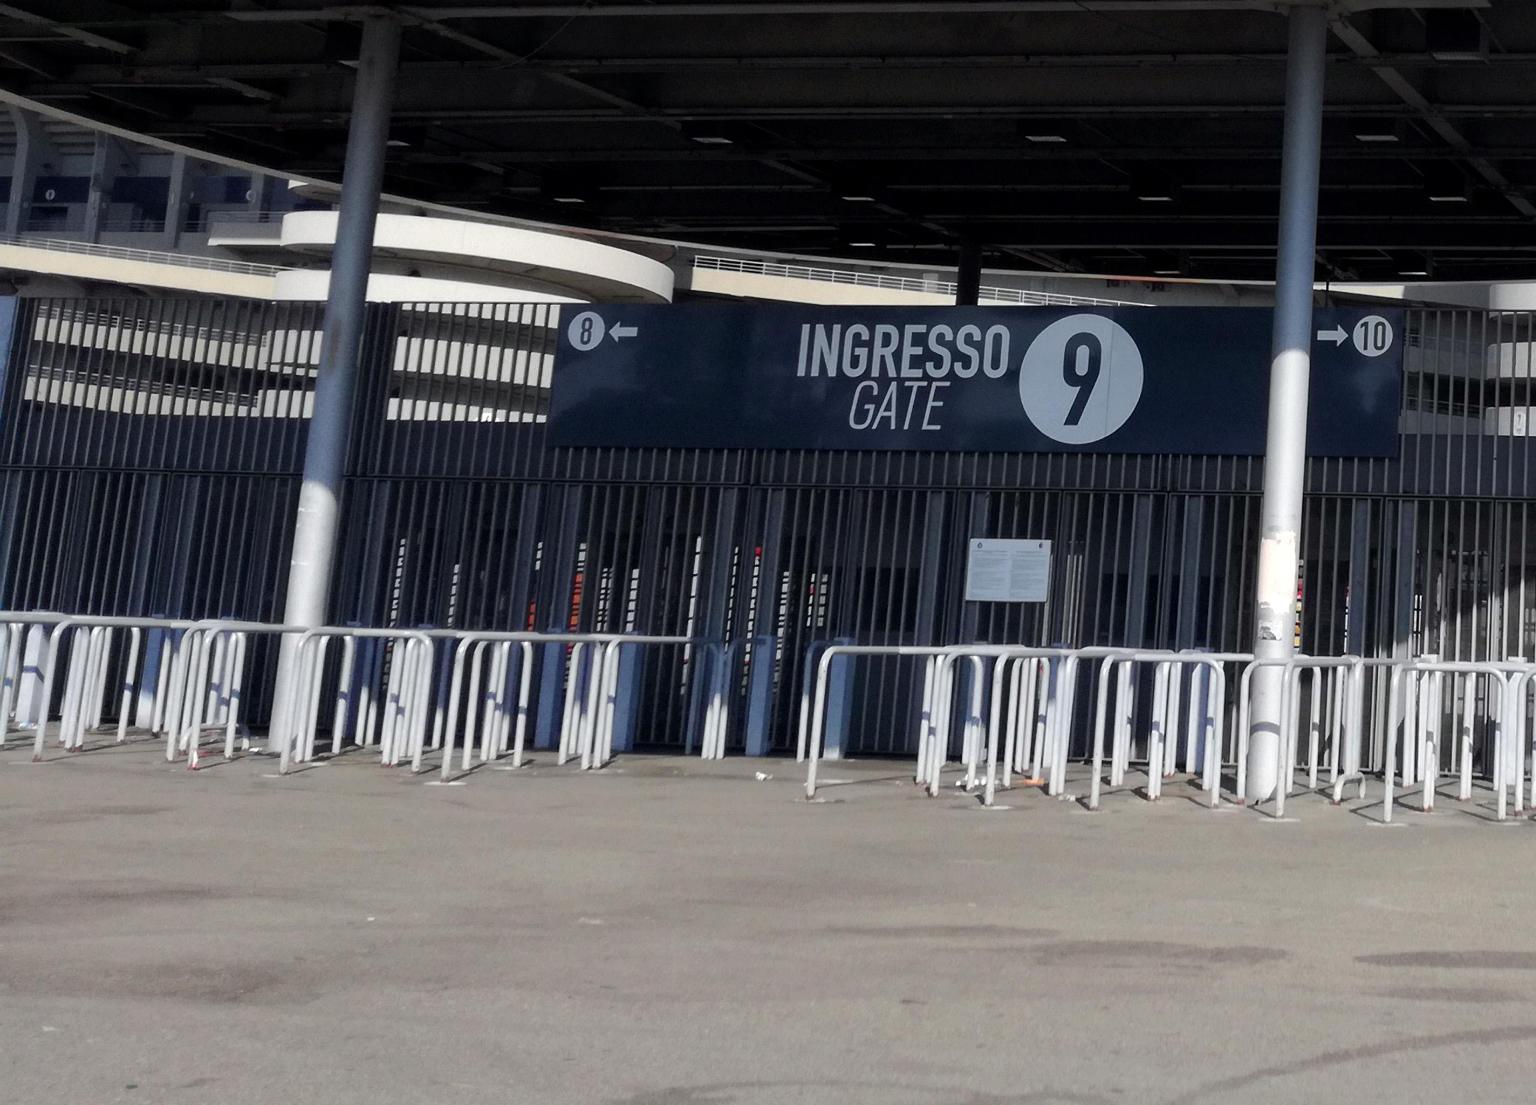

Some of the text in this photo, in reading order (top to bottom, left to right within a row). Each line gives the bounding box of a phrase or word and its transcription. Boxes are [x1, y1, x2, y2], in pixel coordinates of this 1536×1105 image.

[580, 317, 594, 345] 8
[796, 323, 1011, 379] INGRESSO
[1360, 321, 1387, 351] 10
[1062, 331, 1103, 427] 9
[848, 381, 952, 431] GATE
